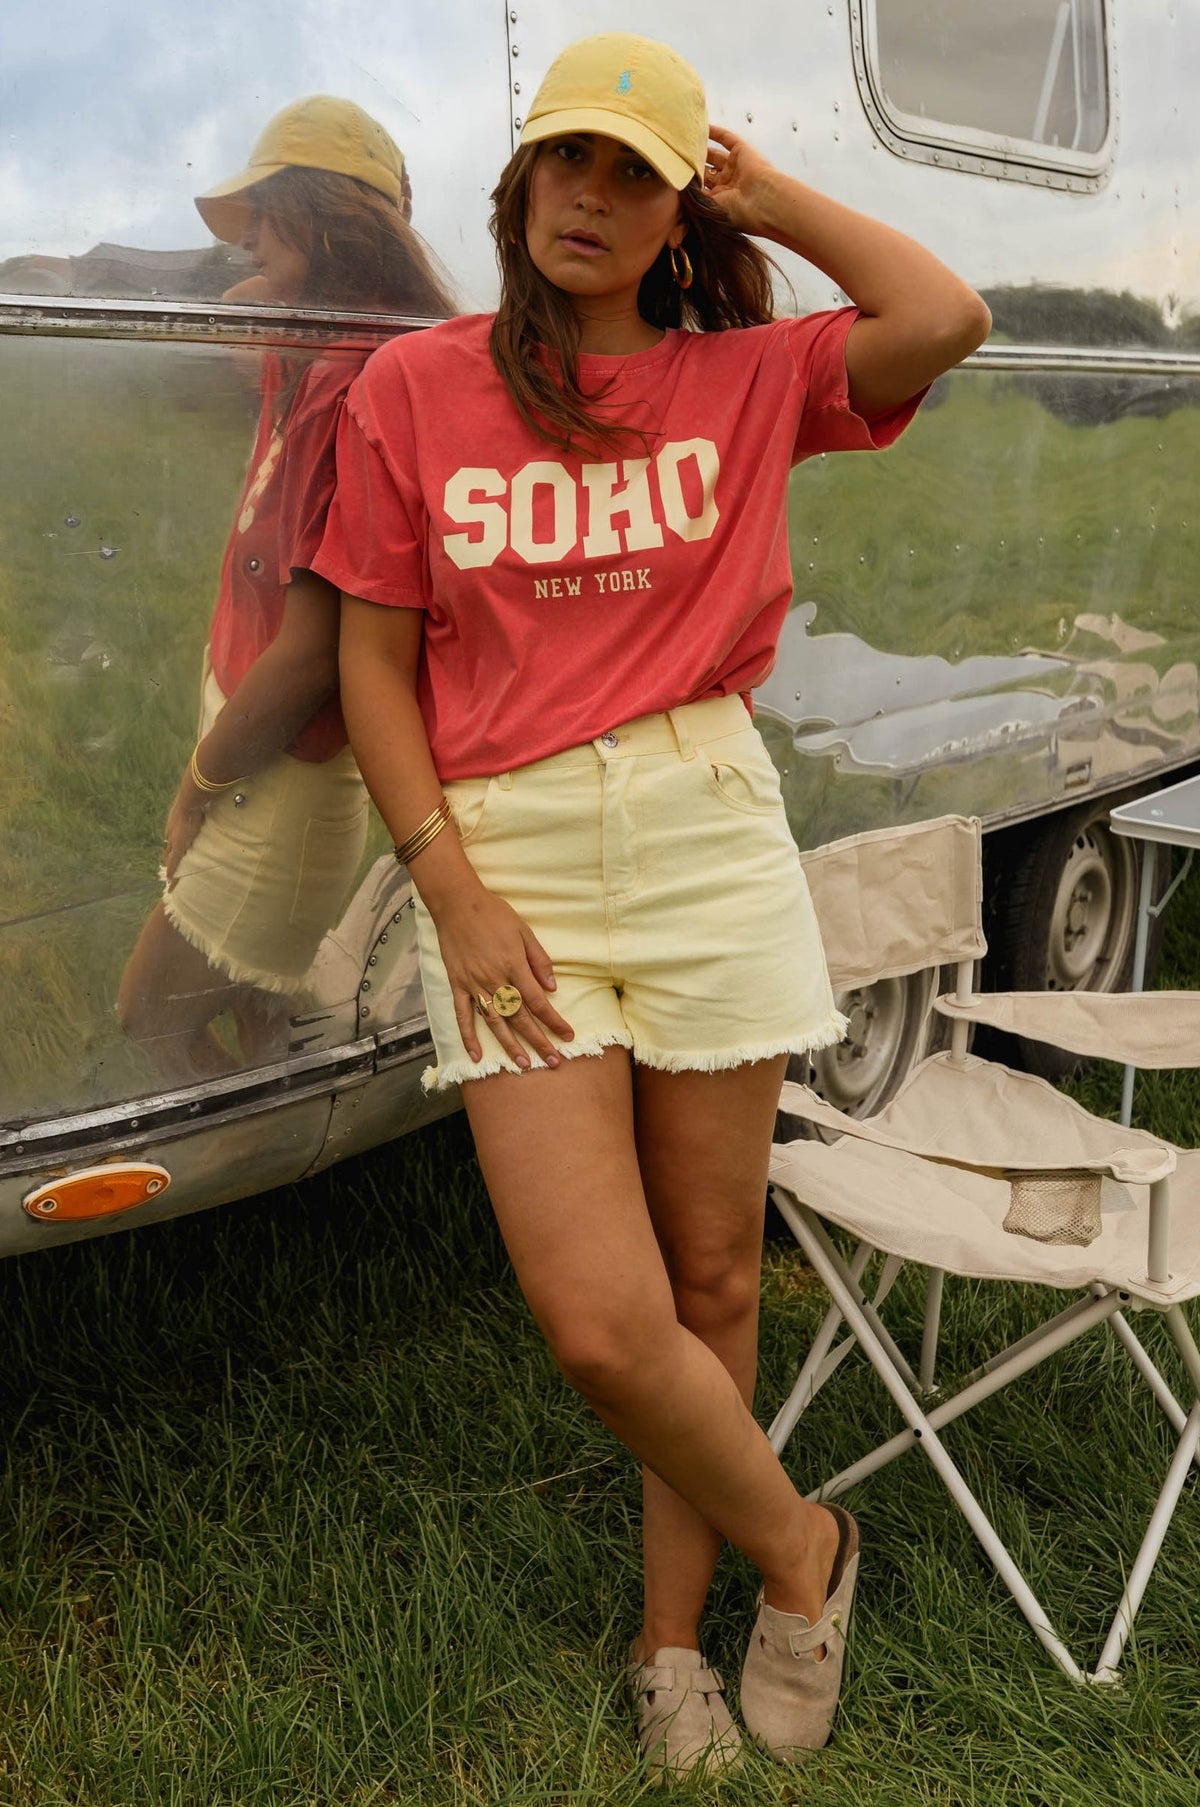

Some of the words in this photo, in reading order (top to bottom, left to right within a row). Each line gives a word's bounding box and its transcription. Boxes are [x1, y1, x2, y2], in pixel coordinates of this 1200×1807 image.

[443, 437, 720, 570] SOHO
[534, 576, 583, 599] NEW
[594, 568, 652, 593] YORK
